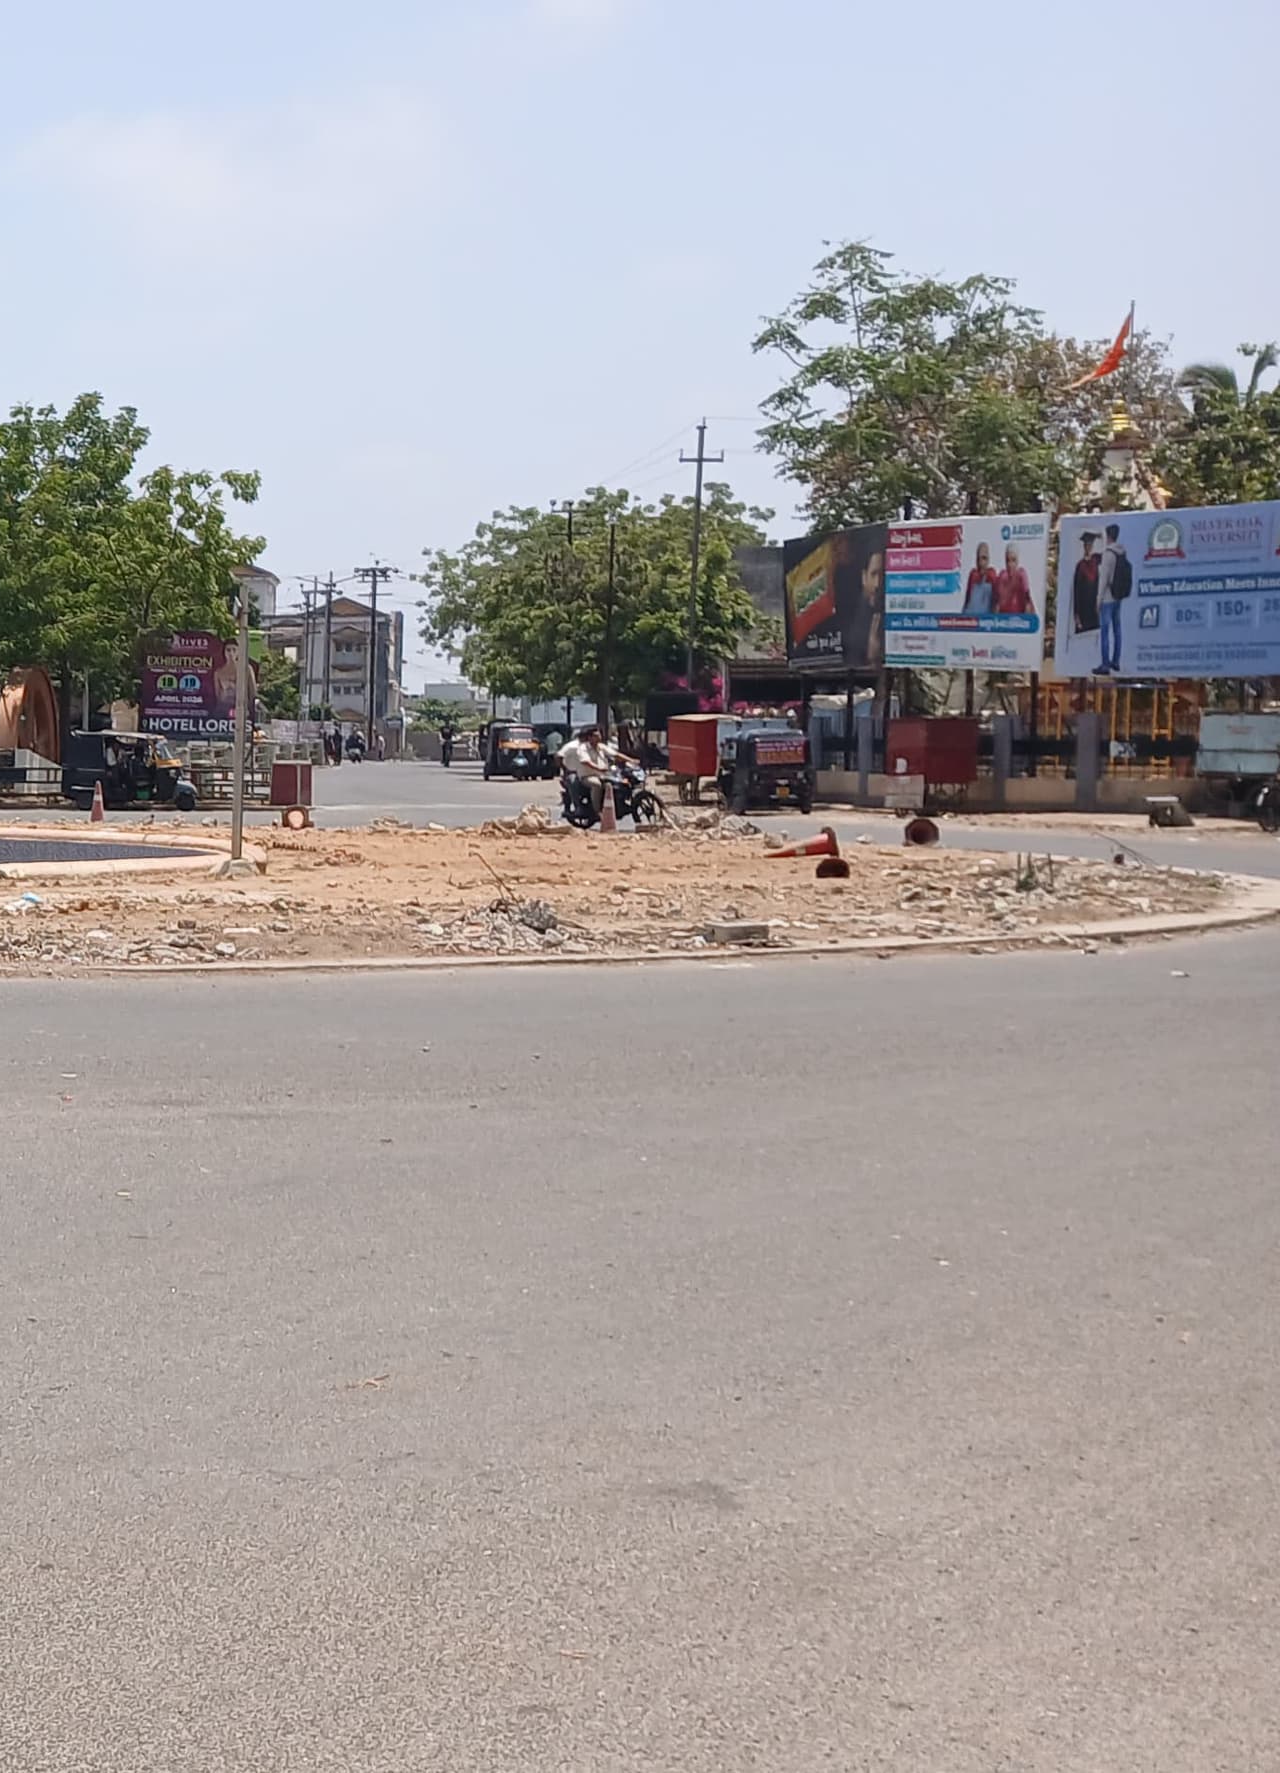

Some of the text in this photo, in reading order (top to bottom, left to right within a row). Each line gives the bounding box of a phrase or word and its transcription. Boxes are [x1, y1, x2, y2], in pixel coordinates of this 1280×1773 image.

[1140, 582, 1172, 594] Where
[1173, 579, 1224, 592] Education
[1226, 577, 1256, 589] Meets
[147, 655, 213, 669] EXHIBITION
[149, 718, 198, 732] HOTEL
